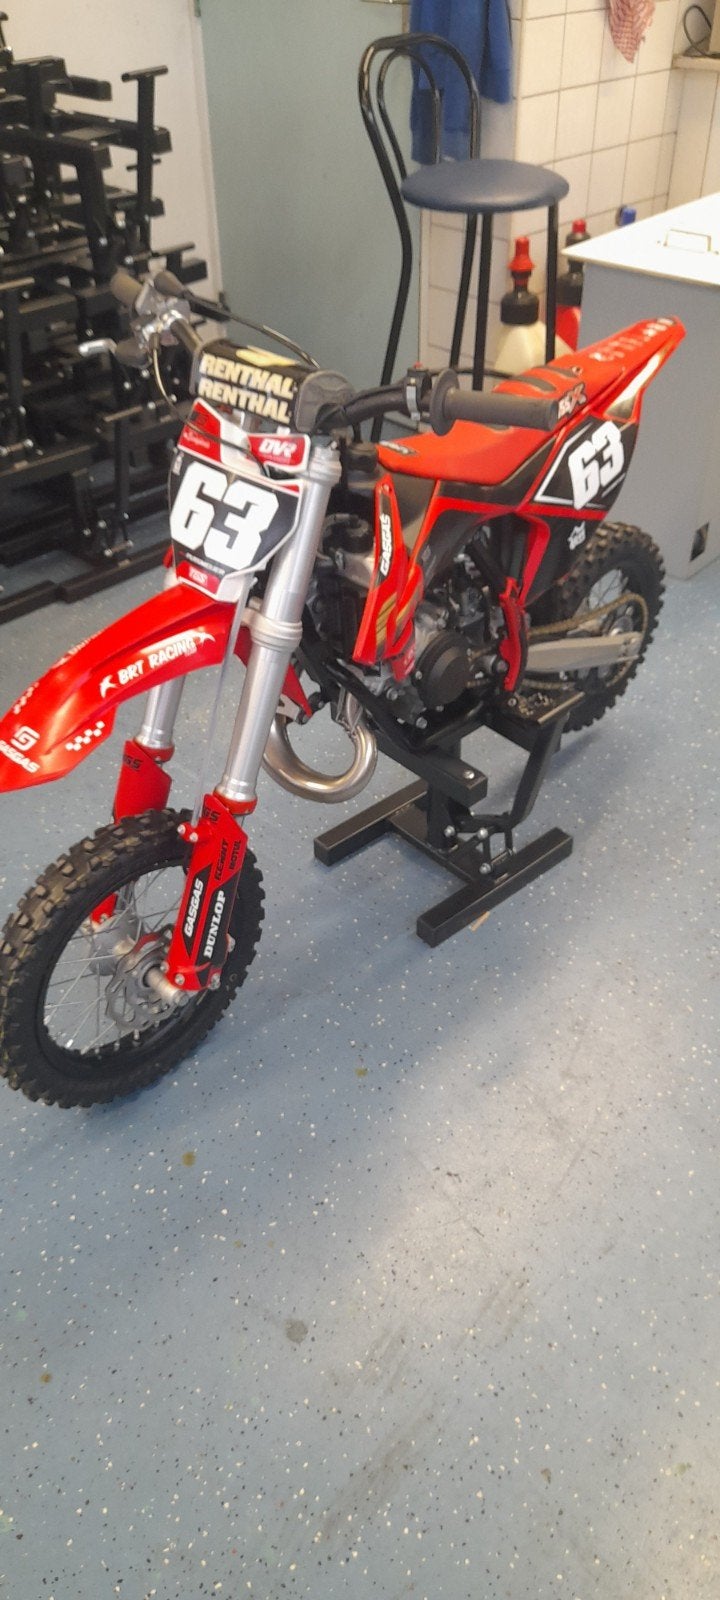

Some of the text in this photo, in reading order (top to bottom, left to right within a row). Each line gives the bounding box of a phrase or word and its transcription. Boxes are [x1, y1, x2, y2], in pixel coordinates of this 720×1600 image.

[198, 378, 291, 424] RENTHAL
[199, 353, 295, 399] RENTHAL
[568, 421, 624, 509] 63
[170, 461, 279, 571] 63
[378, 513, 391, 575] GASGAS
[118, 638, 197, 685] BRT RACING
[229, 840, 242, 870] MOTUL
[184, 878, 204, 939] GASGAS
[203, 890, 226, 960] DUNLOP
